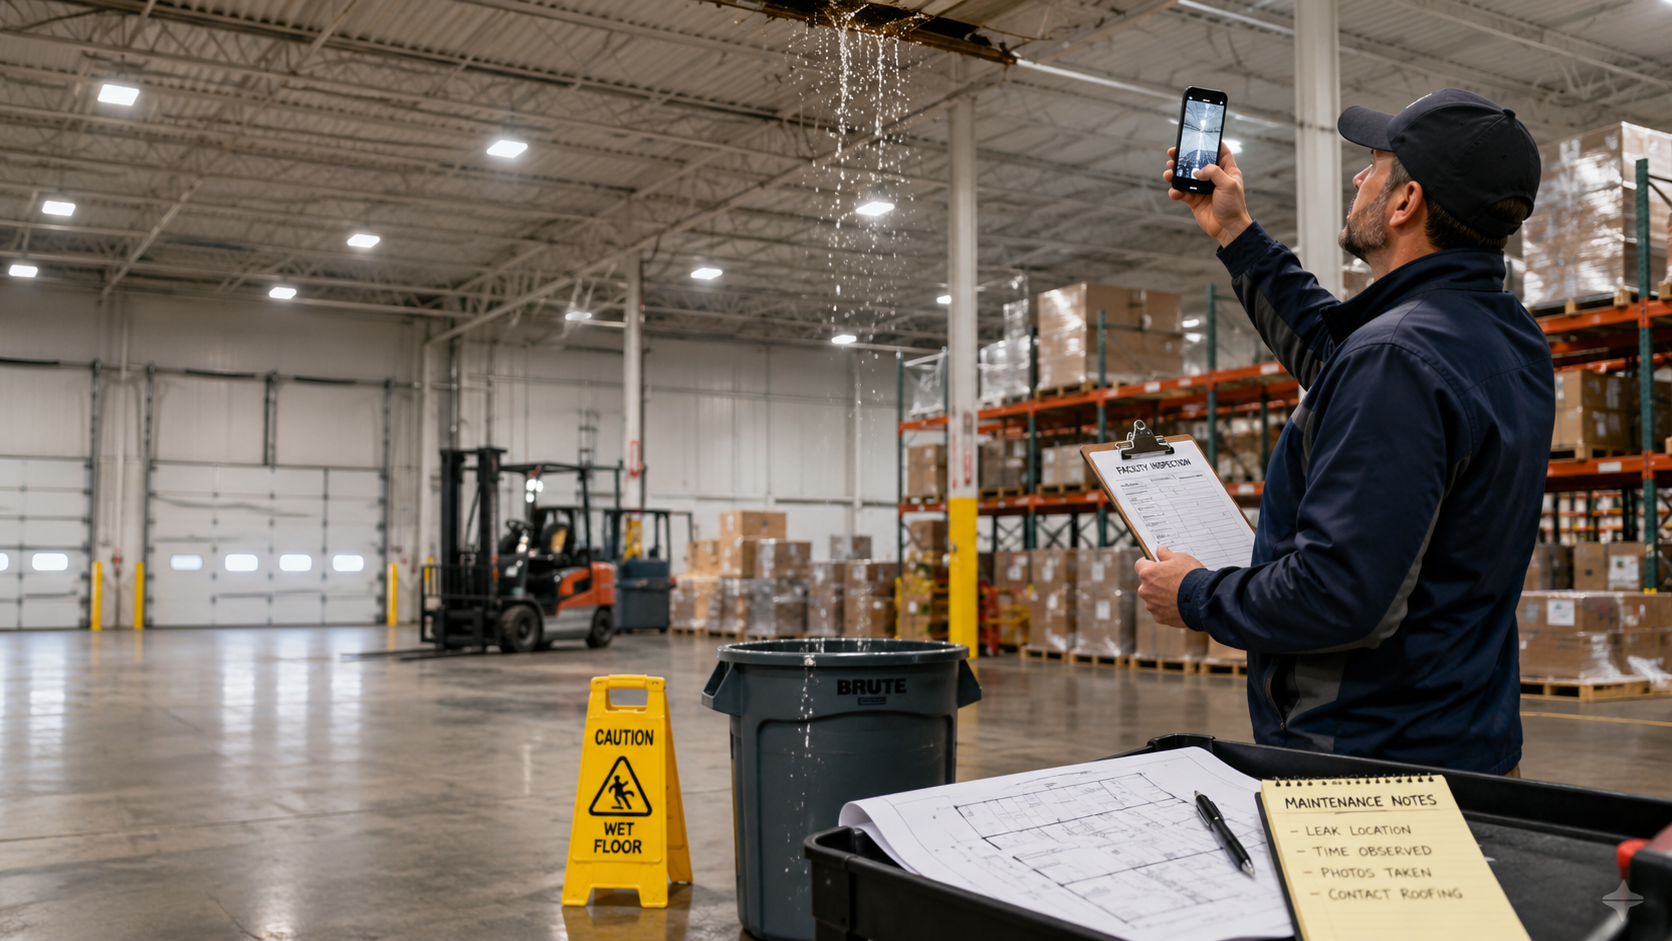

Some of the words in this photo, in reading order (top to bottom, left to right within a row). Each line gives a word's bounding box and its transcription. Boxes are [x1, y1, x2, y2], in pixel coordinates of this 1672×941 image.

[837, 678, 907, 695] BRUTE
[595, 729, 654, 745] CAUTION
[1285, 796, 1384, 809] MAINTENANCE
[1391, 794, 1437, 807] NOTES
[604, 821, 634, 836] WET
[1305, 826, 1341, 836] LEAK
[1350, 825, 1412, 836] LOCATION
[594, 839, 642, 854] FLOOR
[1312, 846, 1350, 857] TIME
[1358, 845, 1432, 857] OBSERVED
[1321, 867, 1375, 878] PHOTOS
[1384, 867, 1432, 878] TAKEN
[1328, 888, 1391, 900] CONTACT
[1400, 888, 1463, 900] ROOFING
